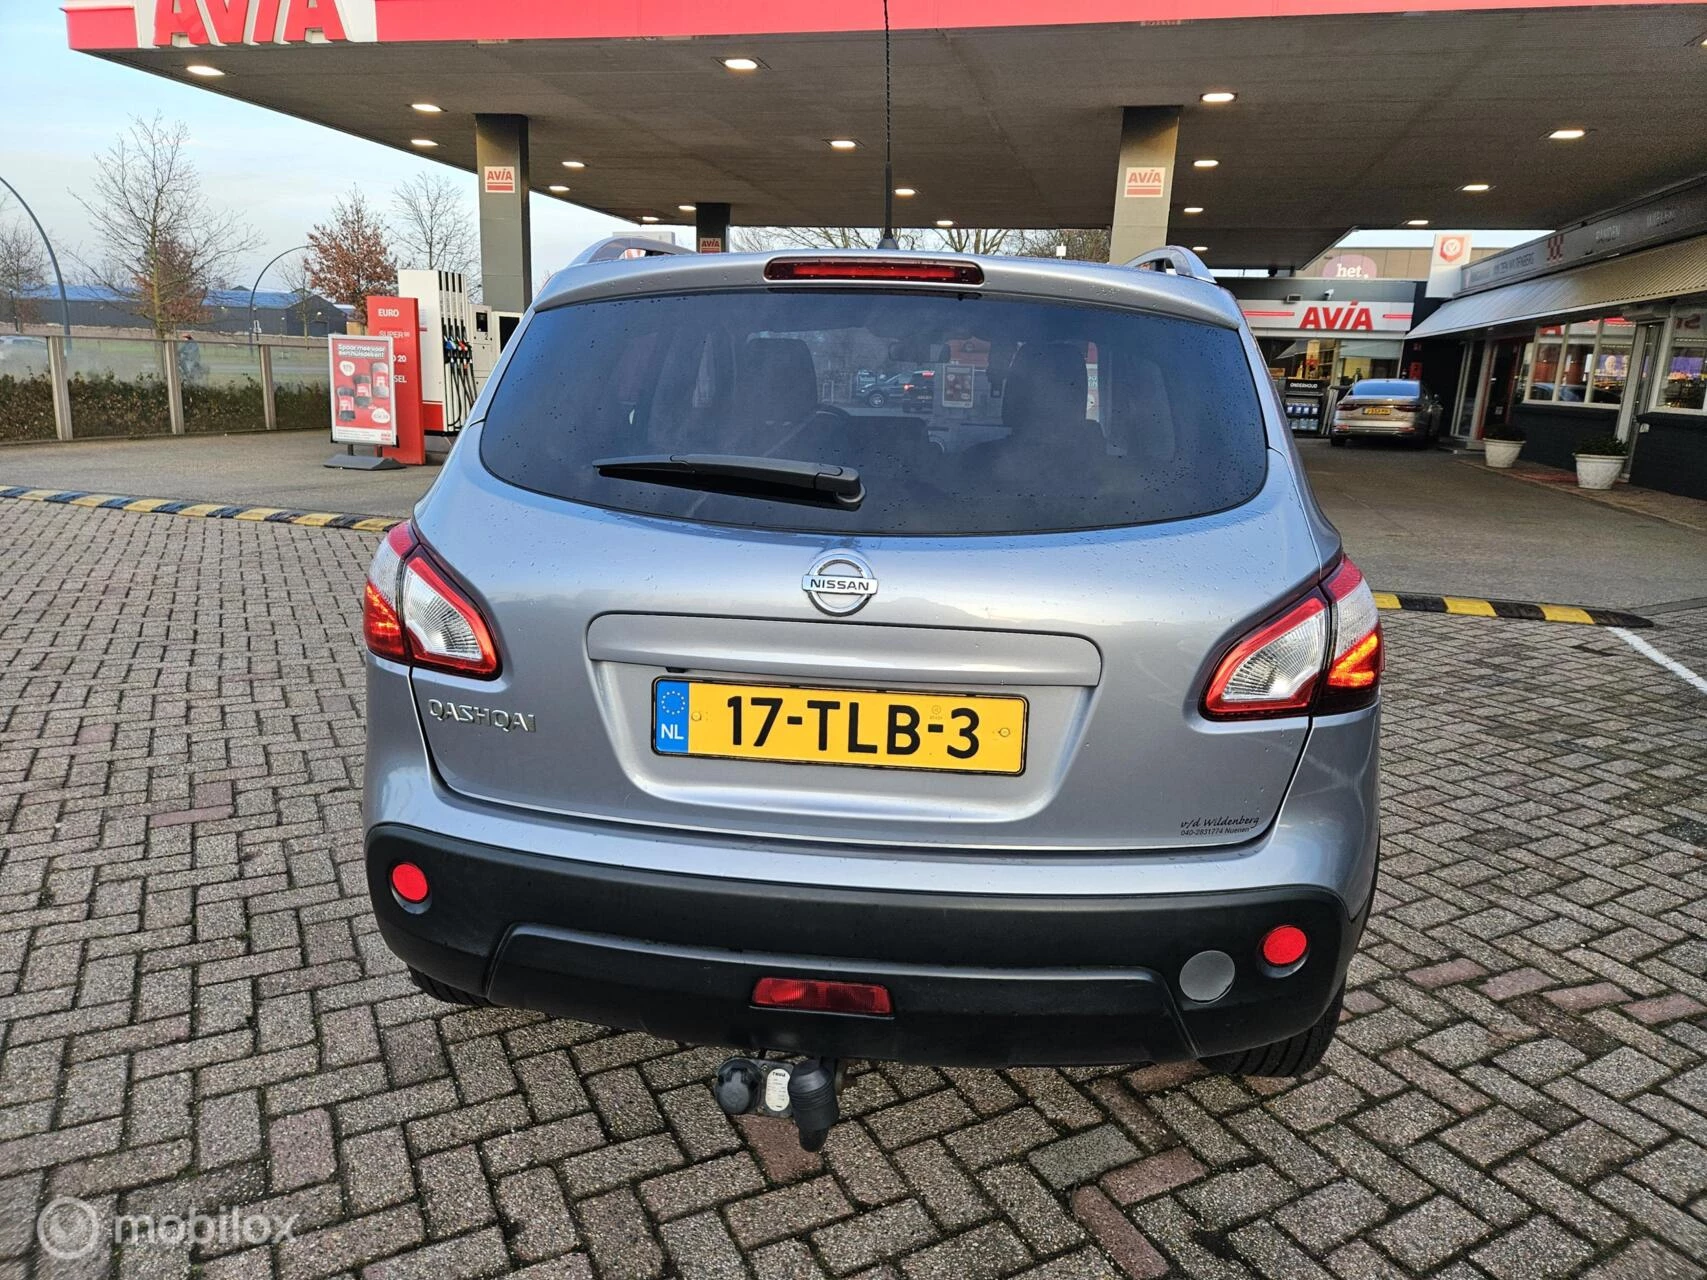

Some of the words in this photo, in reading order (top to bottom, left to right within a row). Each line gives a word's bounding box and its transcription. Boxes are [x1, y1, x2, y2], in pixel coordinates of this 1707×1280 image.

[378, 308, 399, 317] EURO
[810, 578, 869, 591] NISSAN
[428, 699, 536, 732] QASHQAI
[660, 723, 684, 740] NL
[726, 696, 980, 760] 17-TLB-3
[1203, 815, 1260, 829] Wildenberg
